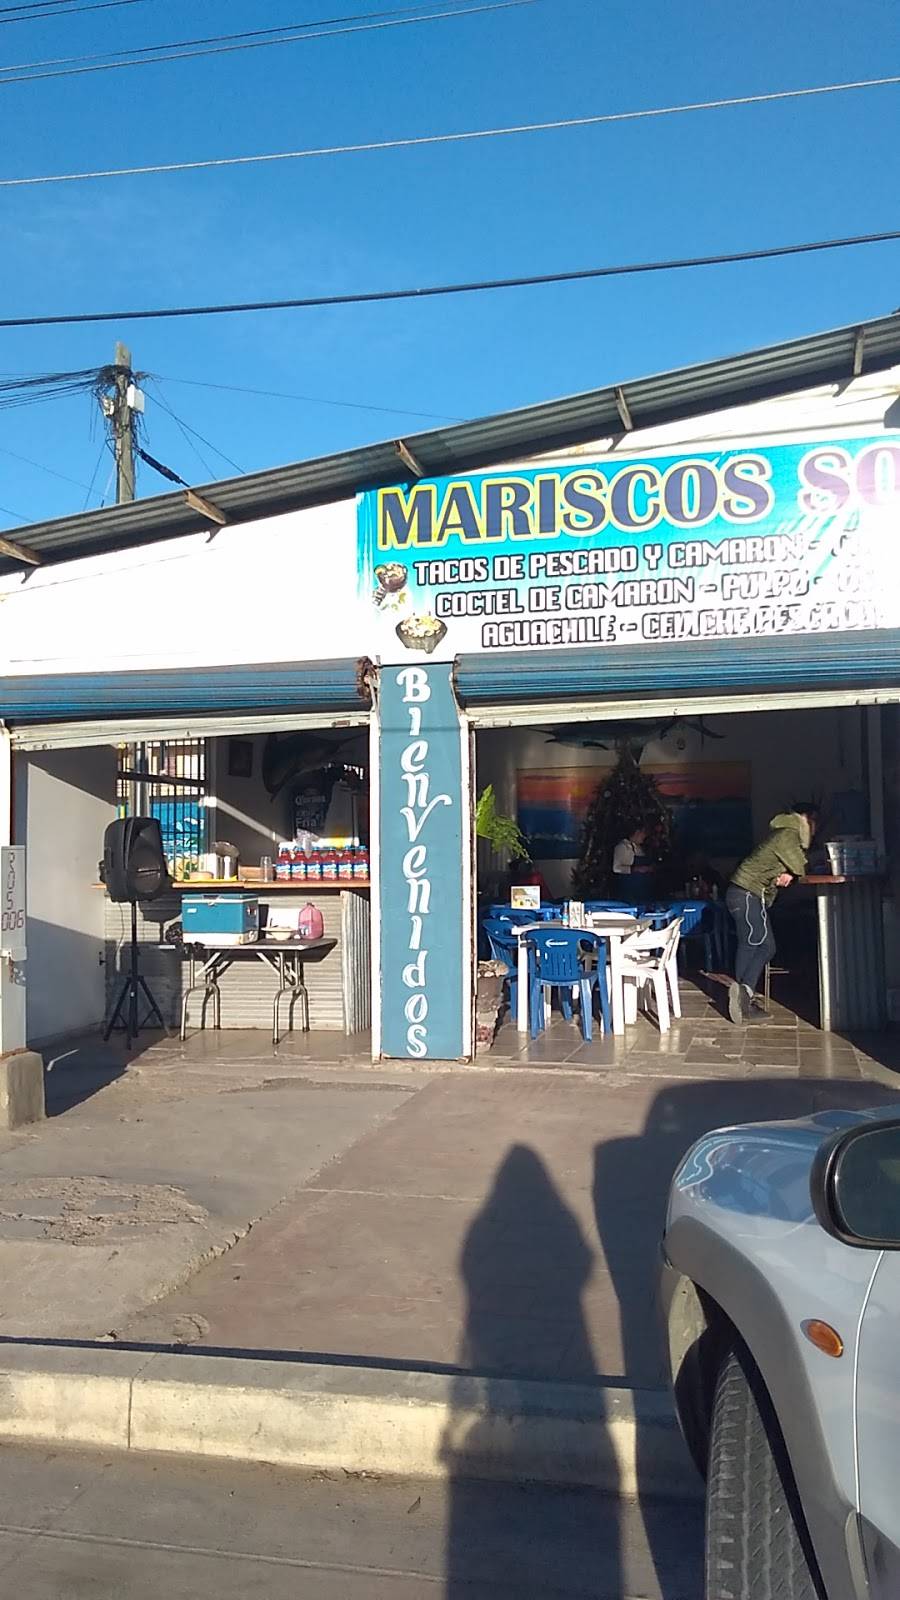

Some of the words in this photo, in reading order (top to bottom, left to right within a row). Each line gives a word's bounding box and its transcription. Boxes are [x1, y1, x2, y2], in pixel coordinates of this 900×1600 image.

[379, 453, 772, 548] MARISCOS
[413, 556, 489, 586] TACOS
[493, 554, 525, 581] DE
[528, 546, 639, 578] PESCADO
[643, 543, 662, 571] Y
[668, 533, 804, 568] CAMARON
[435, 588, 524, 618] COCTEL
[529, 585, 561, 612] DE
[565, 576, 695, 611] CAMARON
[721, 568, 810, 600] PULPO
[482, 615, 616, 648] AGUACHILE
